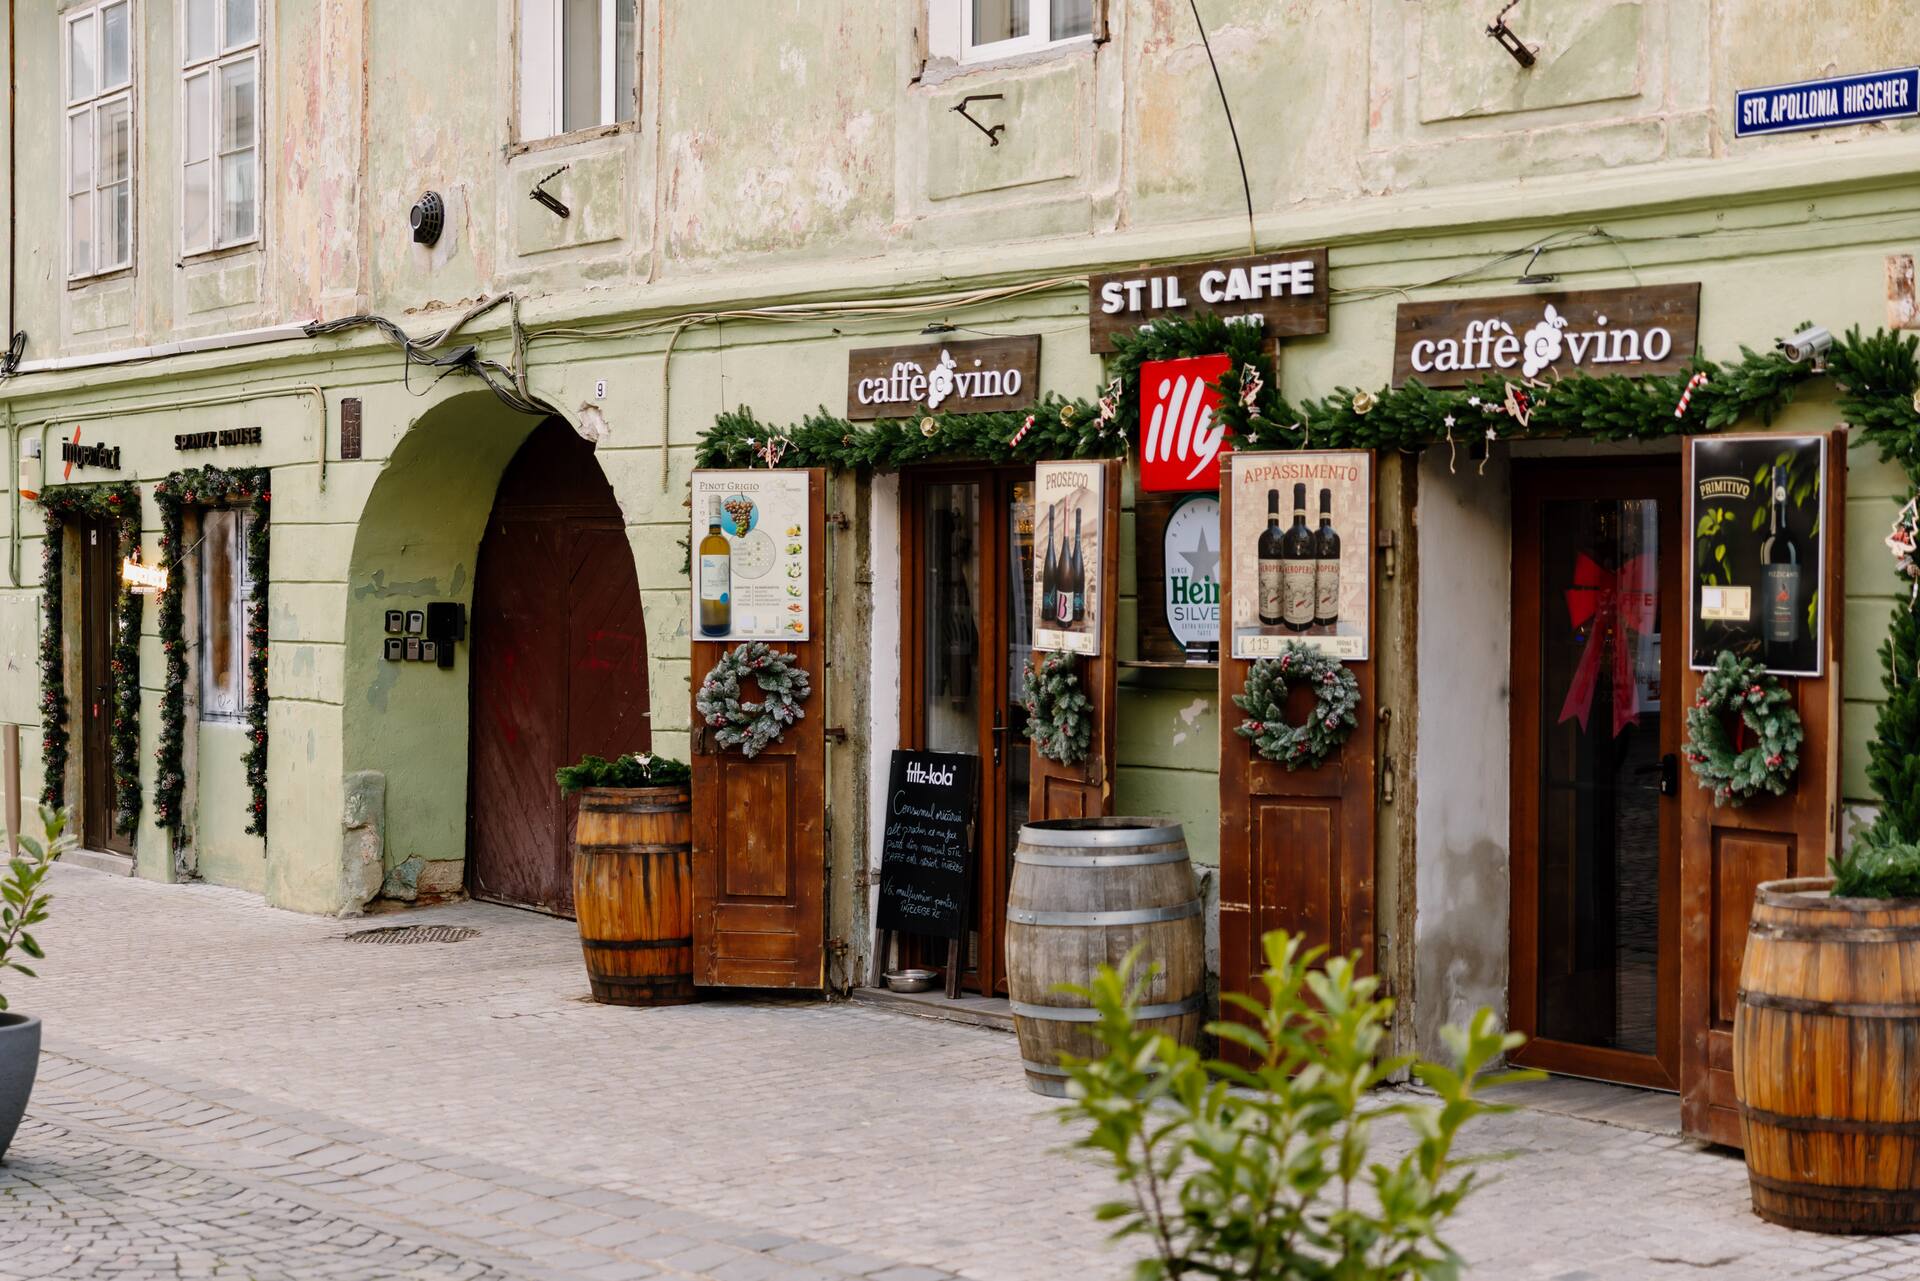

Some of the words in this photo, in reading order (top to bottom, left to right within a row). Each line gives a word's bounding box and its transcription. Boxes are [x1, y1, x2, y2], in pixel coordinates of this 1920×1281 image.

[1743, 97, 1770, 126] STR.
[1771, 88, 1839, 122] APOLLONIA
[1843, 78, 1909, 114] HIRSCHER
[1101, 275, 1187, 314] STIL
[1199, 260, 1315, 304] CAFFE
[1410, 319, 1521, 373] caffè
[1564, 315, 1672, 365] vino
[597, 382, 603, 397] 9
[857, 361, 928, 405] caffè
[954, 359, 1023, 399] vino
[219, 426, 262, 447] HOUSE
[1145, 374, 1226, 481] illy
[1045, 471, 1089, 490] PROSECCO
[1244, 463, 1359, 484] APPASSIMENTO
[700, 481, 726, 490] PINOT
[727, 481, 760, 491] GRIGIO
[1699, 480, 1750, 497] PRIMITIVO
